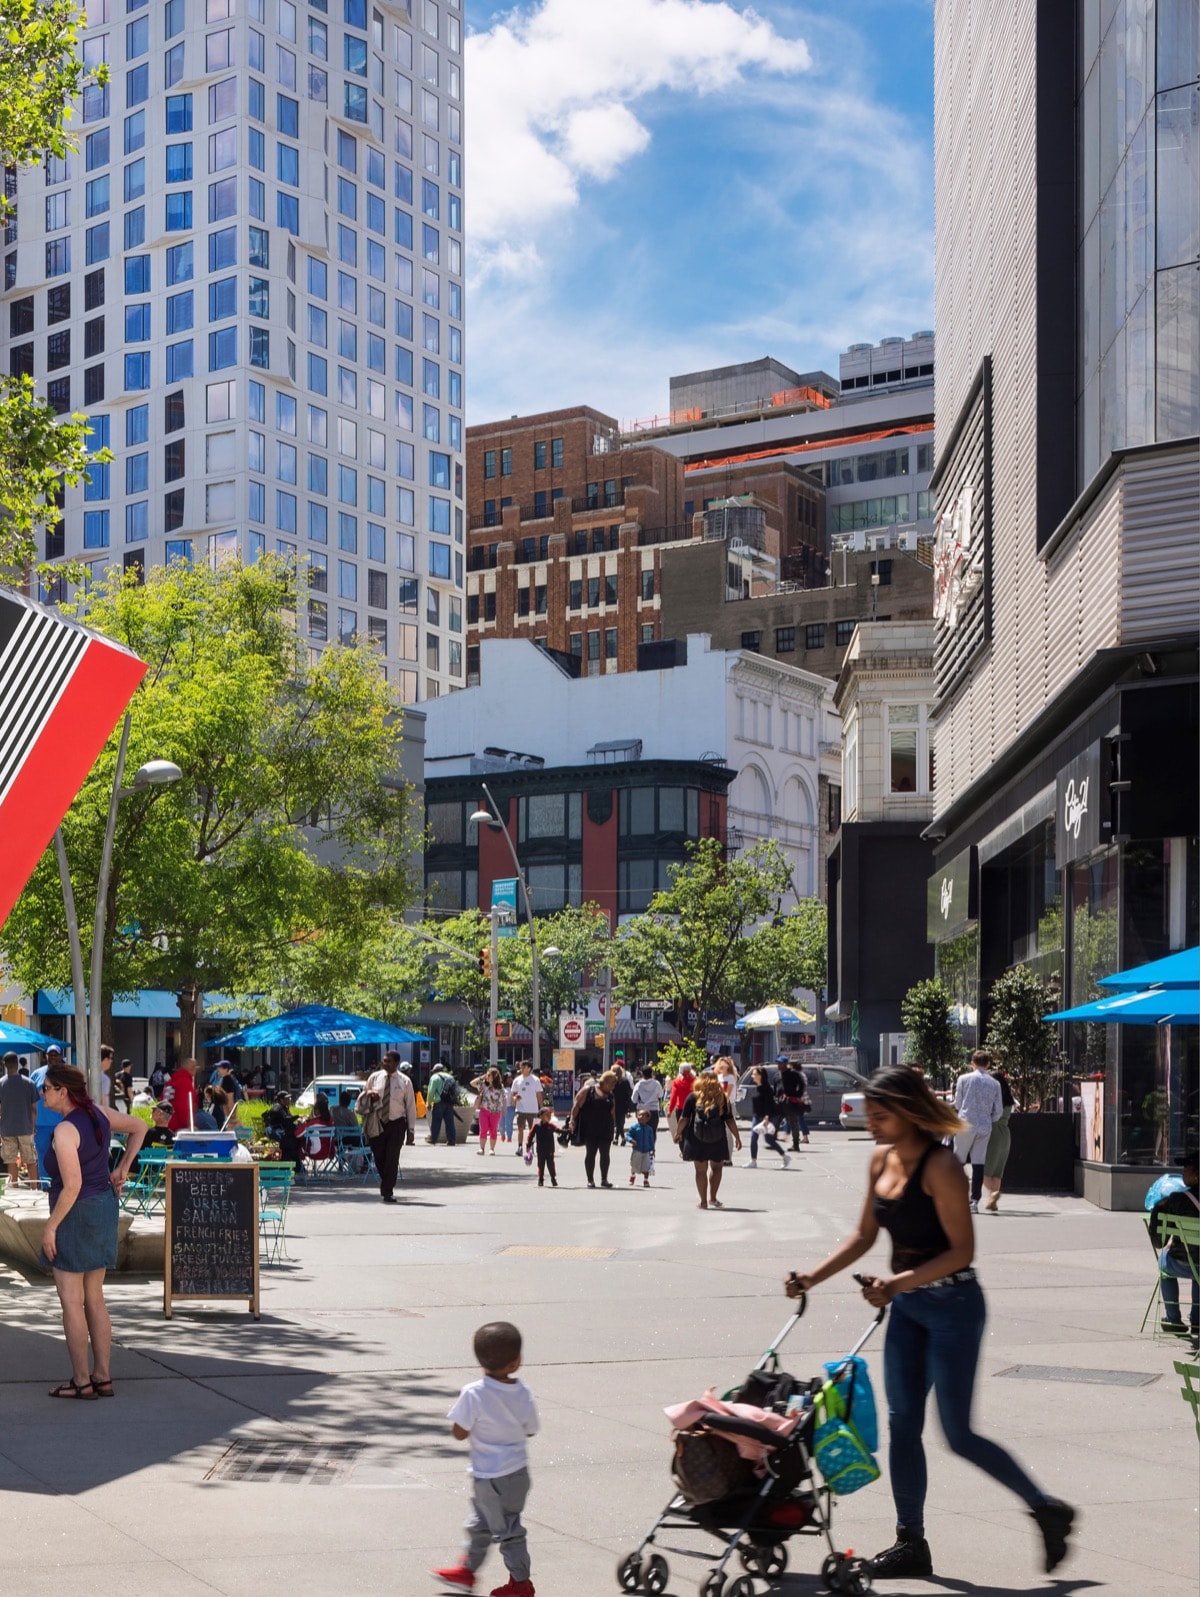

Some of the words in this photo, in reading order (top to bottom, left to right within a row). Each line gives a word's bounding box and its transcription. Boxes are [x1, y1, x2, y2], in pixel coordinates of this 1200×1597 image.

[190, 1183, 227, 1197] BEEF
[186, 1197, 237, 1213] URKEY
[181, 1208, 237, 1224] SALMON
[176, 1225, 216, 1239] FRENCH
[219, 1228, 249, 1242] FRIES
[173, 1241, 251, 1254] SMOOTHIES
[172, 1253, 208, 1265] FRESH
